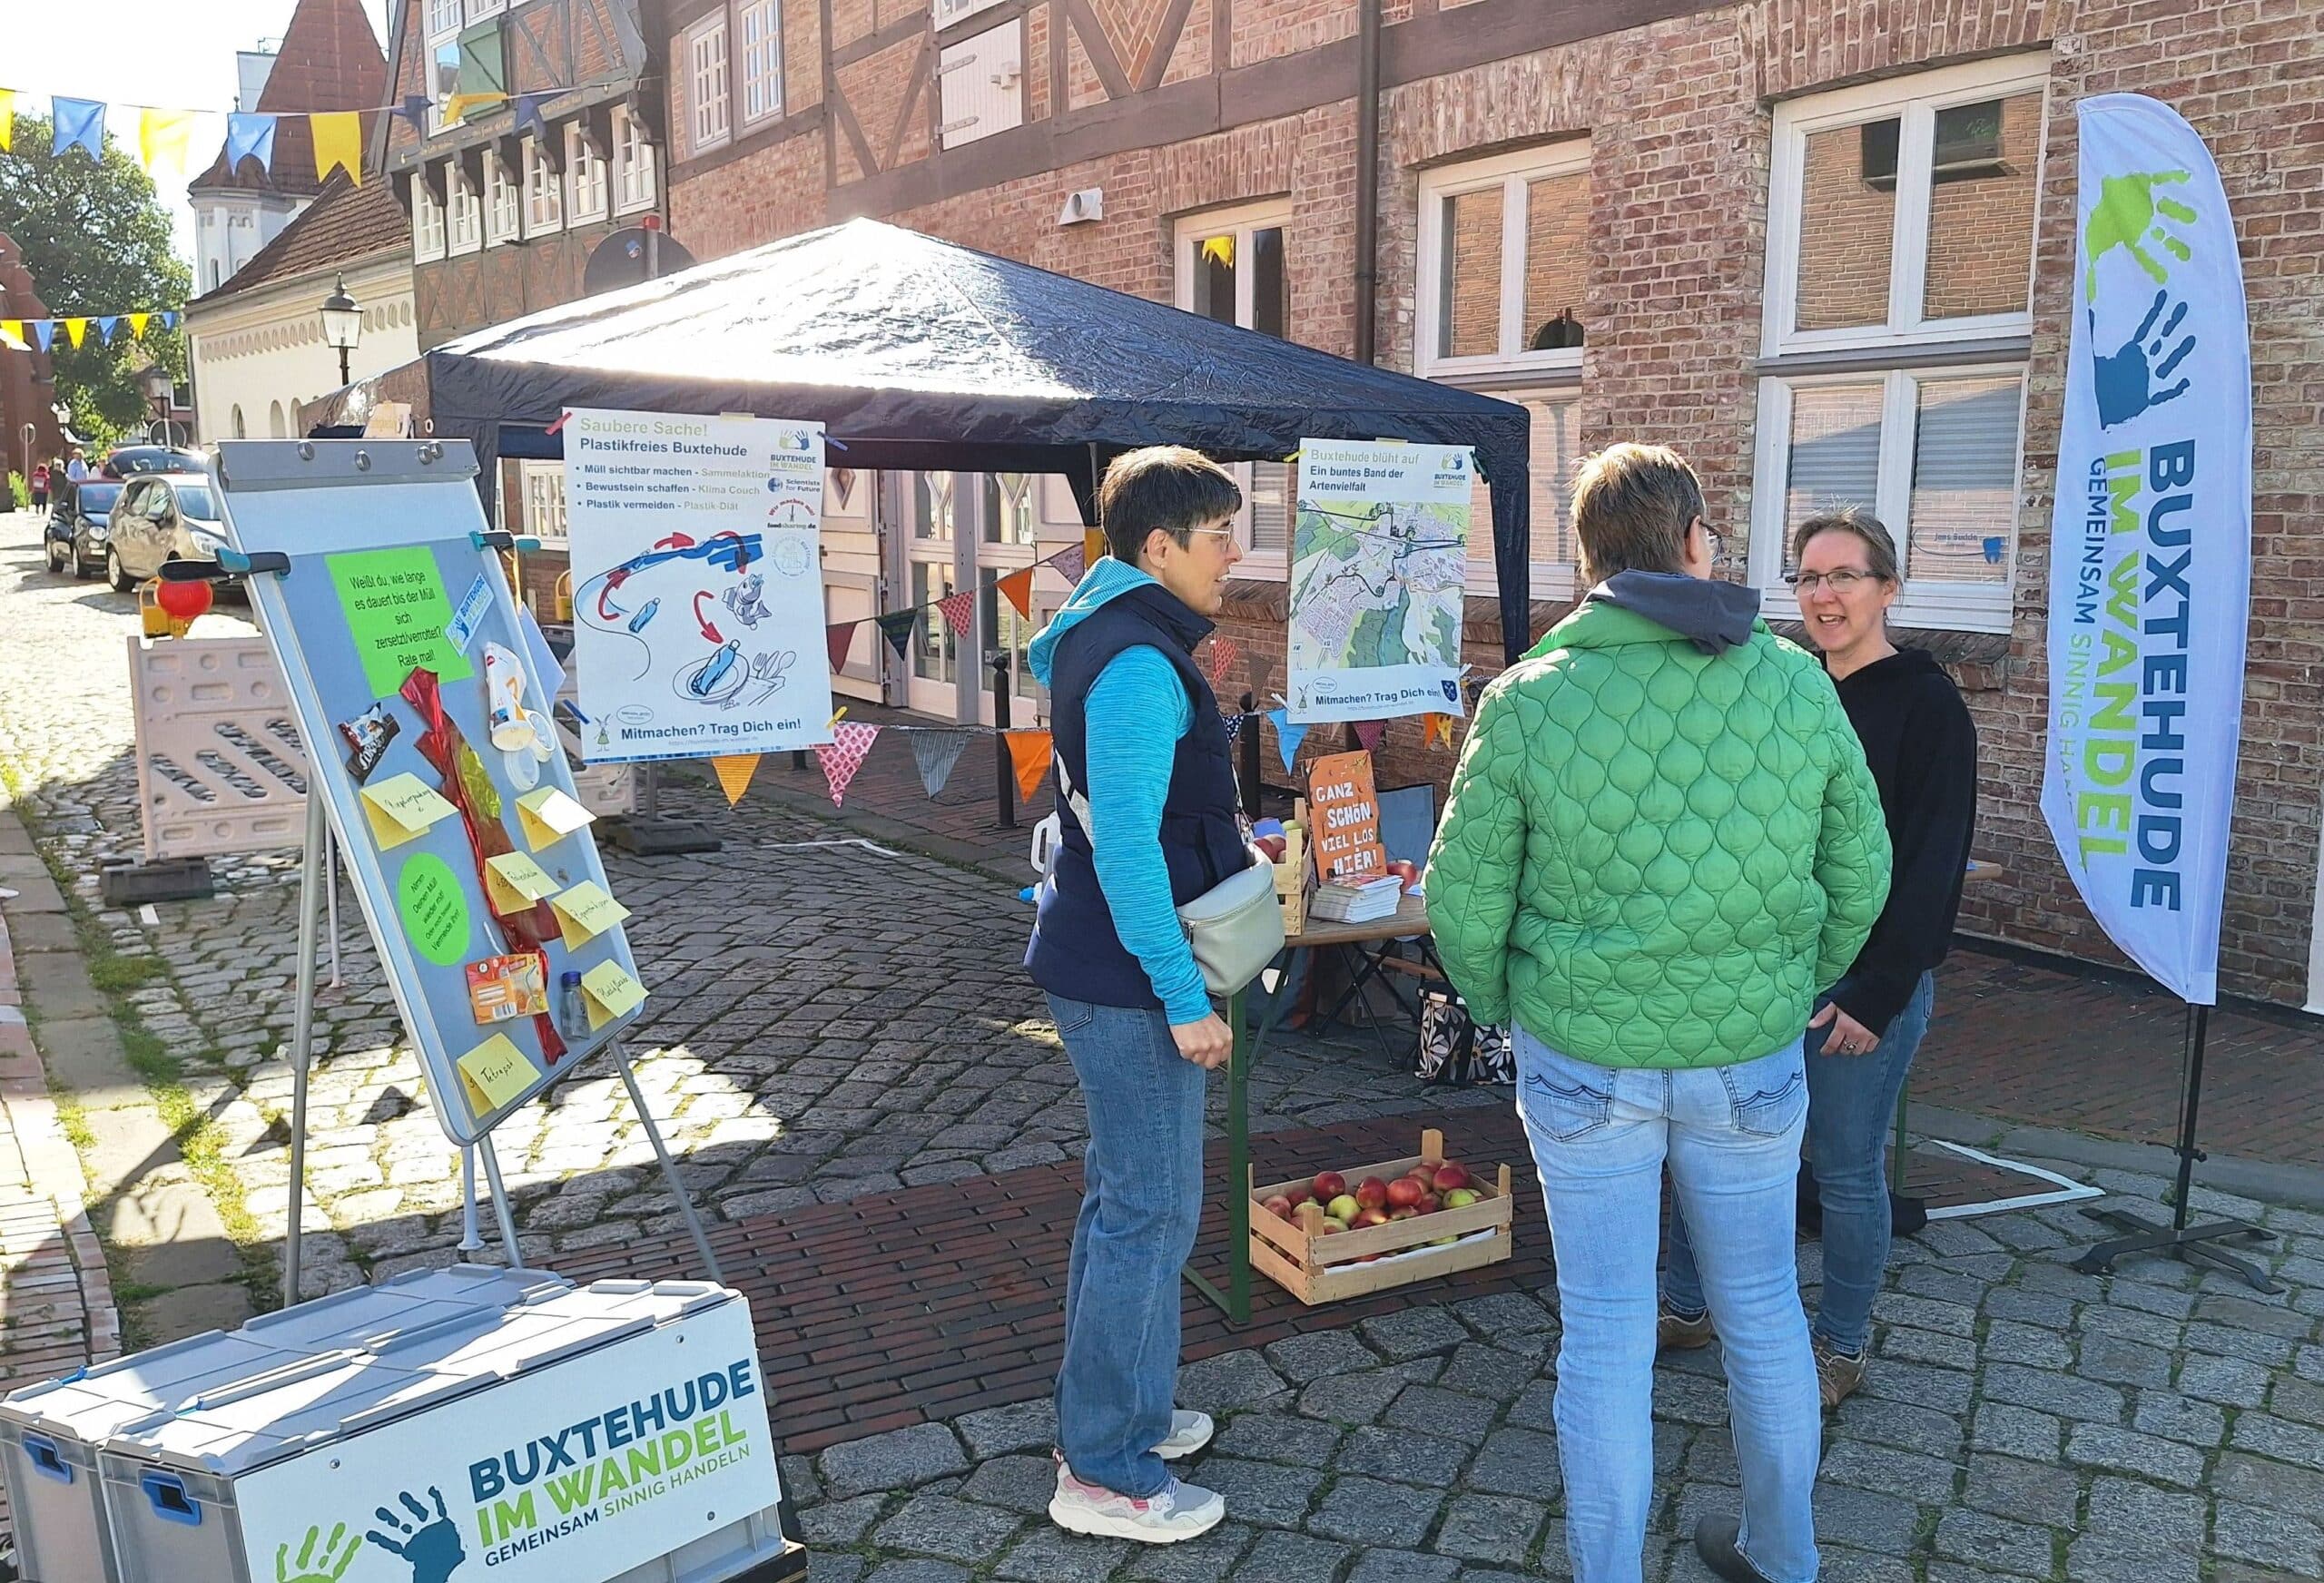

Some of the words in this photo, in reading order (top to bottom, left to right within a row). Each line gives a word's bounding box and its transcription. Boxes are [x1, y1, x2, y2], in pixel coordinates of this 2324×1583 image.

[580, 418, 648, 434] Saubere
[654, 421, 708, 436] Sache!
[580, 438, 668, 453] Plastikfreies
[673, 441, 747, 457] Buxtehude
[770, 454, 817, 464] BUXTEHUDE
[1310, 449, 1370, 463] Buxtehude
[1373, 452, 1399, 464] blüht
[1402, 454, 1421, 466] auf
[585, 465, 606, 474] Müll
[609, 465, 651, 476] sichtbar
[654, 467, 693, 477] machen
[701, 468, 770, 479] Sammelaktion
[1310, 466, 1327, 476] Ein
[1330, 467, 1362, 477] buntes
[1364, 467, 1386, 478] Band
[1388, 468, 1405, 478] der
[586, 482, 644, 492] Bewustsein
[647, 483, 690, 493] schaffen
[698, 485, 726, 494] Klima
[729, 486, 761, 495] Couch
[786, 478, 821, 487] Scientists
[1309, 480, 1366, 492] Artenvielfalt
[2105, 448, 2142, 536] IM
[586, 499, 621, 509] Plastik
[623, 500, 675, 510] vermeiden
[2073, 457, 2108, 624] GEMEINSAM
[349, 575, 376, 589] Weißt
[390, 572, 405, 585] wie
[404, 571, 426, 585] lange
[354, 599, 366, 611] es
[367, 595, 392, 608] dauert
[392, 592, 406, 605] bis
[406, 590, 419, 603] der
[419, 587, 436, 601] Müll
[395, 612, 412, 625] sich
[397, 652, 419, 668] Rate
[2059, 632, 2093, 730] SINNIG
[2131, 439, 2195, 911] BUXTEHUDE
[1315, 693, 1372, 705] Mitmachen?
[1374, 692, 1398, 703] Trag
[1401, 688, 1425, 699] Dich
[2078, 549, 2141, 870] WANDEL
[621, 723, 705, 741] Mitmachen?
[710, 723, 739, 736] Trag
[743, 720, 773, 733] Dich
[777, 718, 802, 730] ein!
[1315, 782, 1354, 802] GANZ
[1321, 834, 1350, 852] VIEL
[1354, 828, 1374, 846] LOS
[468, 1359, 754, 1503] BUXTEHUDE
[476, 1490, 537, 1549] IM
[544, 1409, 747, 1516] WANDEL
[485, 1509, 599, 1568] GEMEINSAM
[604, 1480, 665, 1518] SINNIG
[670, 1443, 752, 1490] HANDELN
